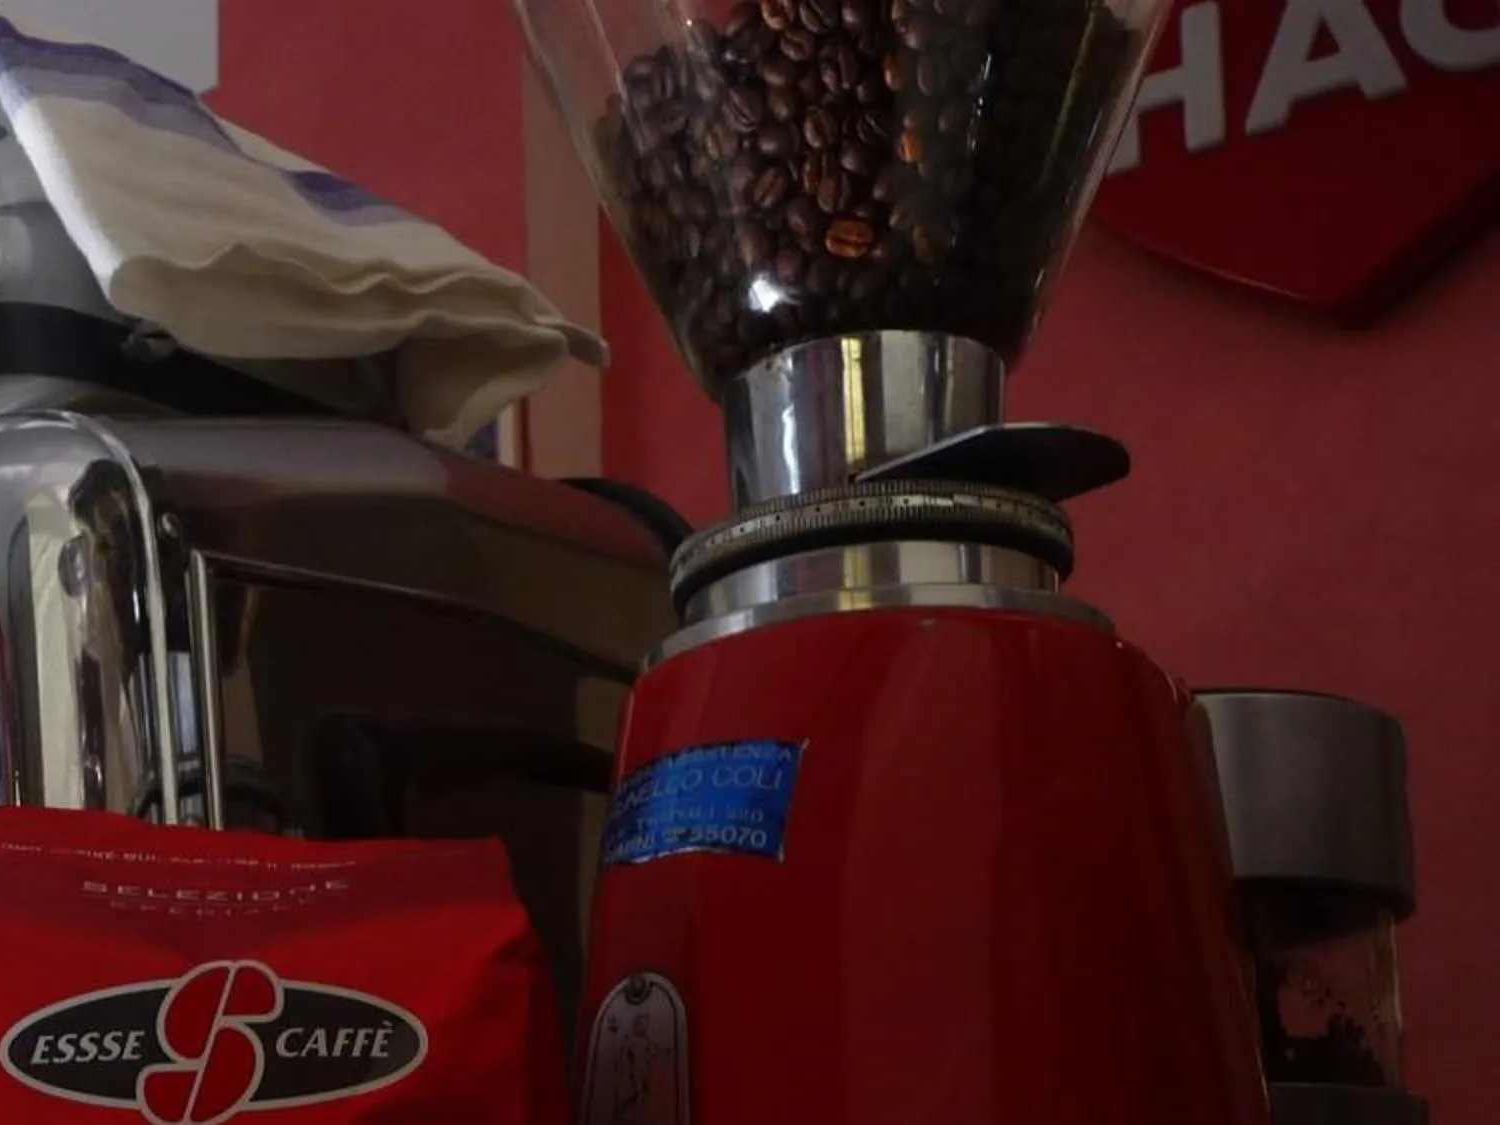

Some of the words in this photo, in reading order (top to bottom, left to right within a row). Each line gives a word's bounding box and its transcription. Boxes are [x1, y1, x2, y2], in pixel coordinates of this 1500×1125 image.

[711, 765, 783, 790] COLI
[82, 879, 349, 900] SELEZIONE
[30, 1029, 146, 1064] ESSSE
[276, 1020, 394, 1059] CAFFÈ
